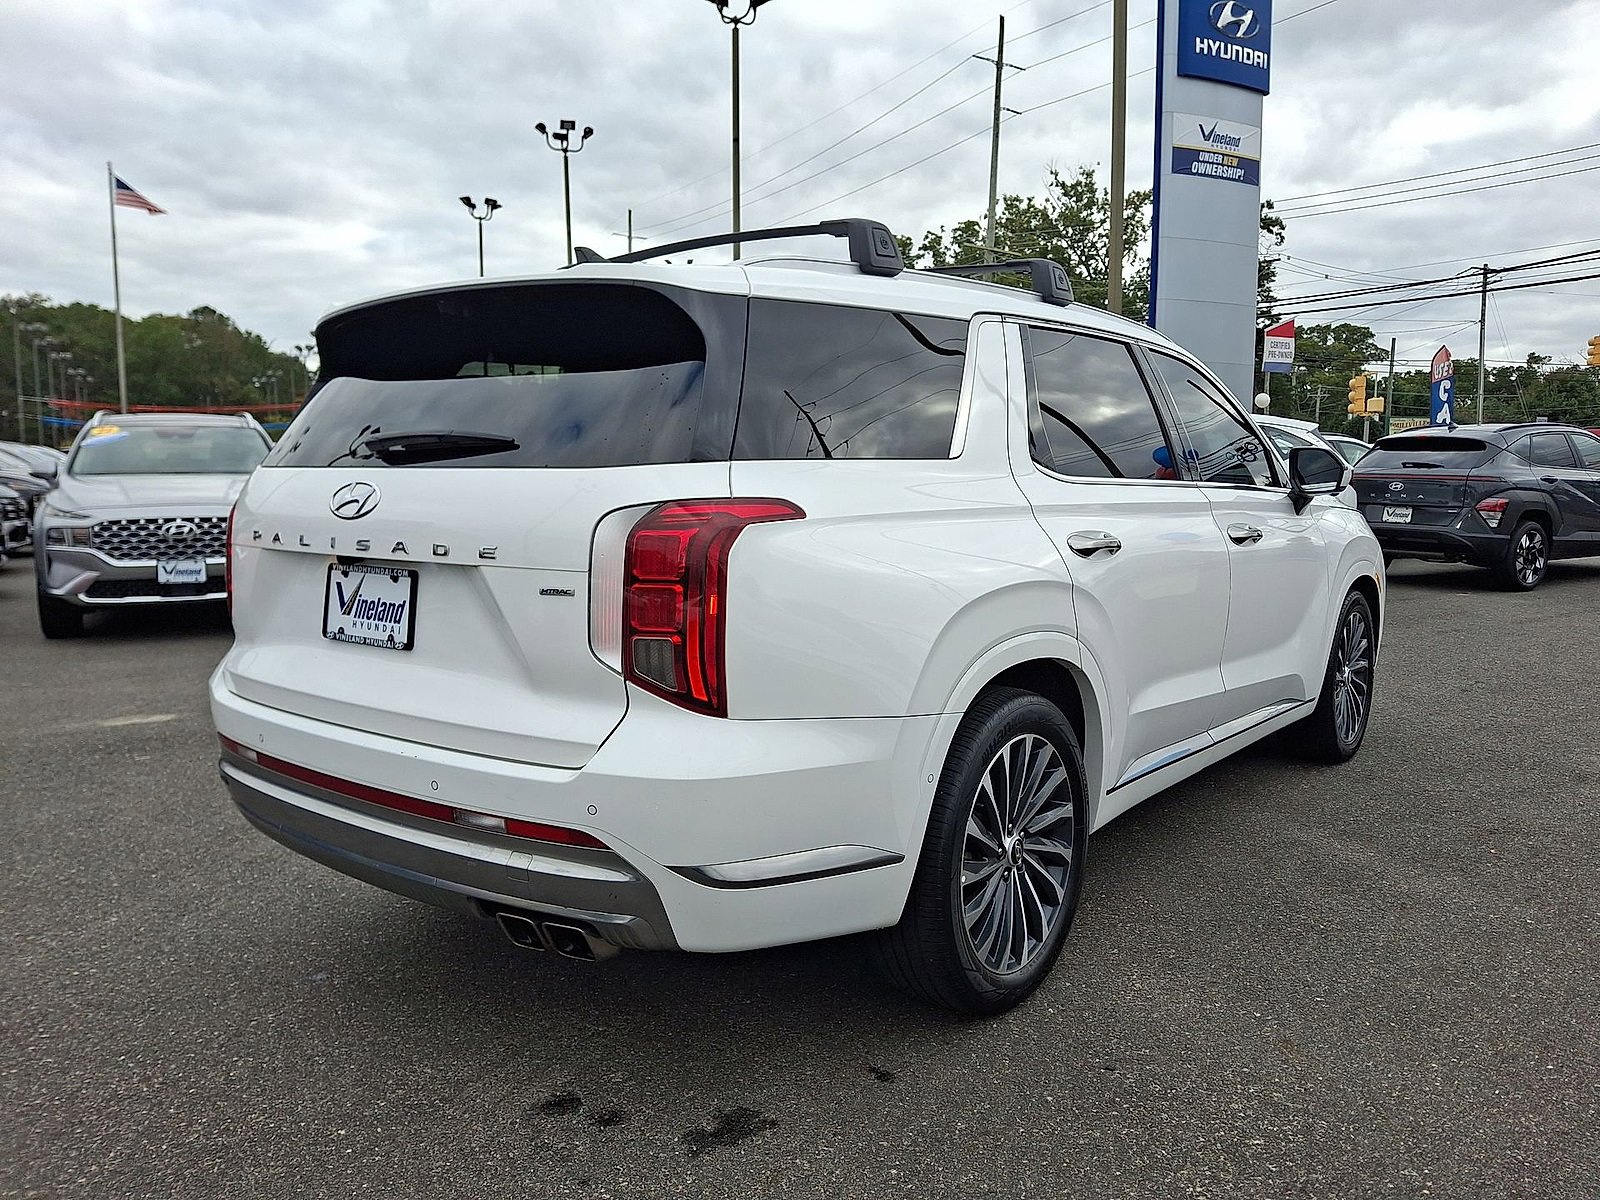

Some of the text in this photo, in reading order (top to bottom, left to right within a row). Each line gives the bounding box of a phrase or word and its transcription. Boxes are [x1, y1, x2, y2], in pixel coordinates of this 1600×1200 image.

[1195, 36, 1268, 70] HYUNDAI
[1198, 121, 1242, 148] Vineland
[1199, 151, 1239, 167] UNDER NEW
[1191, 161, 1245, 180] OWNERSHIP!
[1270, 340, 1291, 350] CERTIFIED
[1267, 350, 1293, 359] PRE-OWNED
[253, 530, 498, 560] PALISADE
[162, 562, 202, 577] Vineland
[335, 573, 407, 625] Vineland
[352, 620, 401, 635] HYUNDAI
[336, 633, 394, 648] VINELAND HYUNDAI
